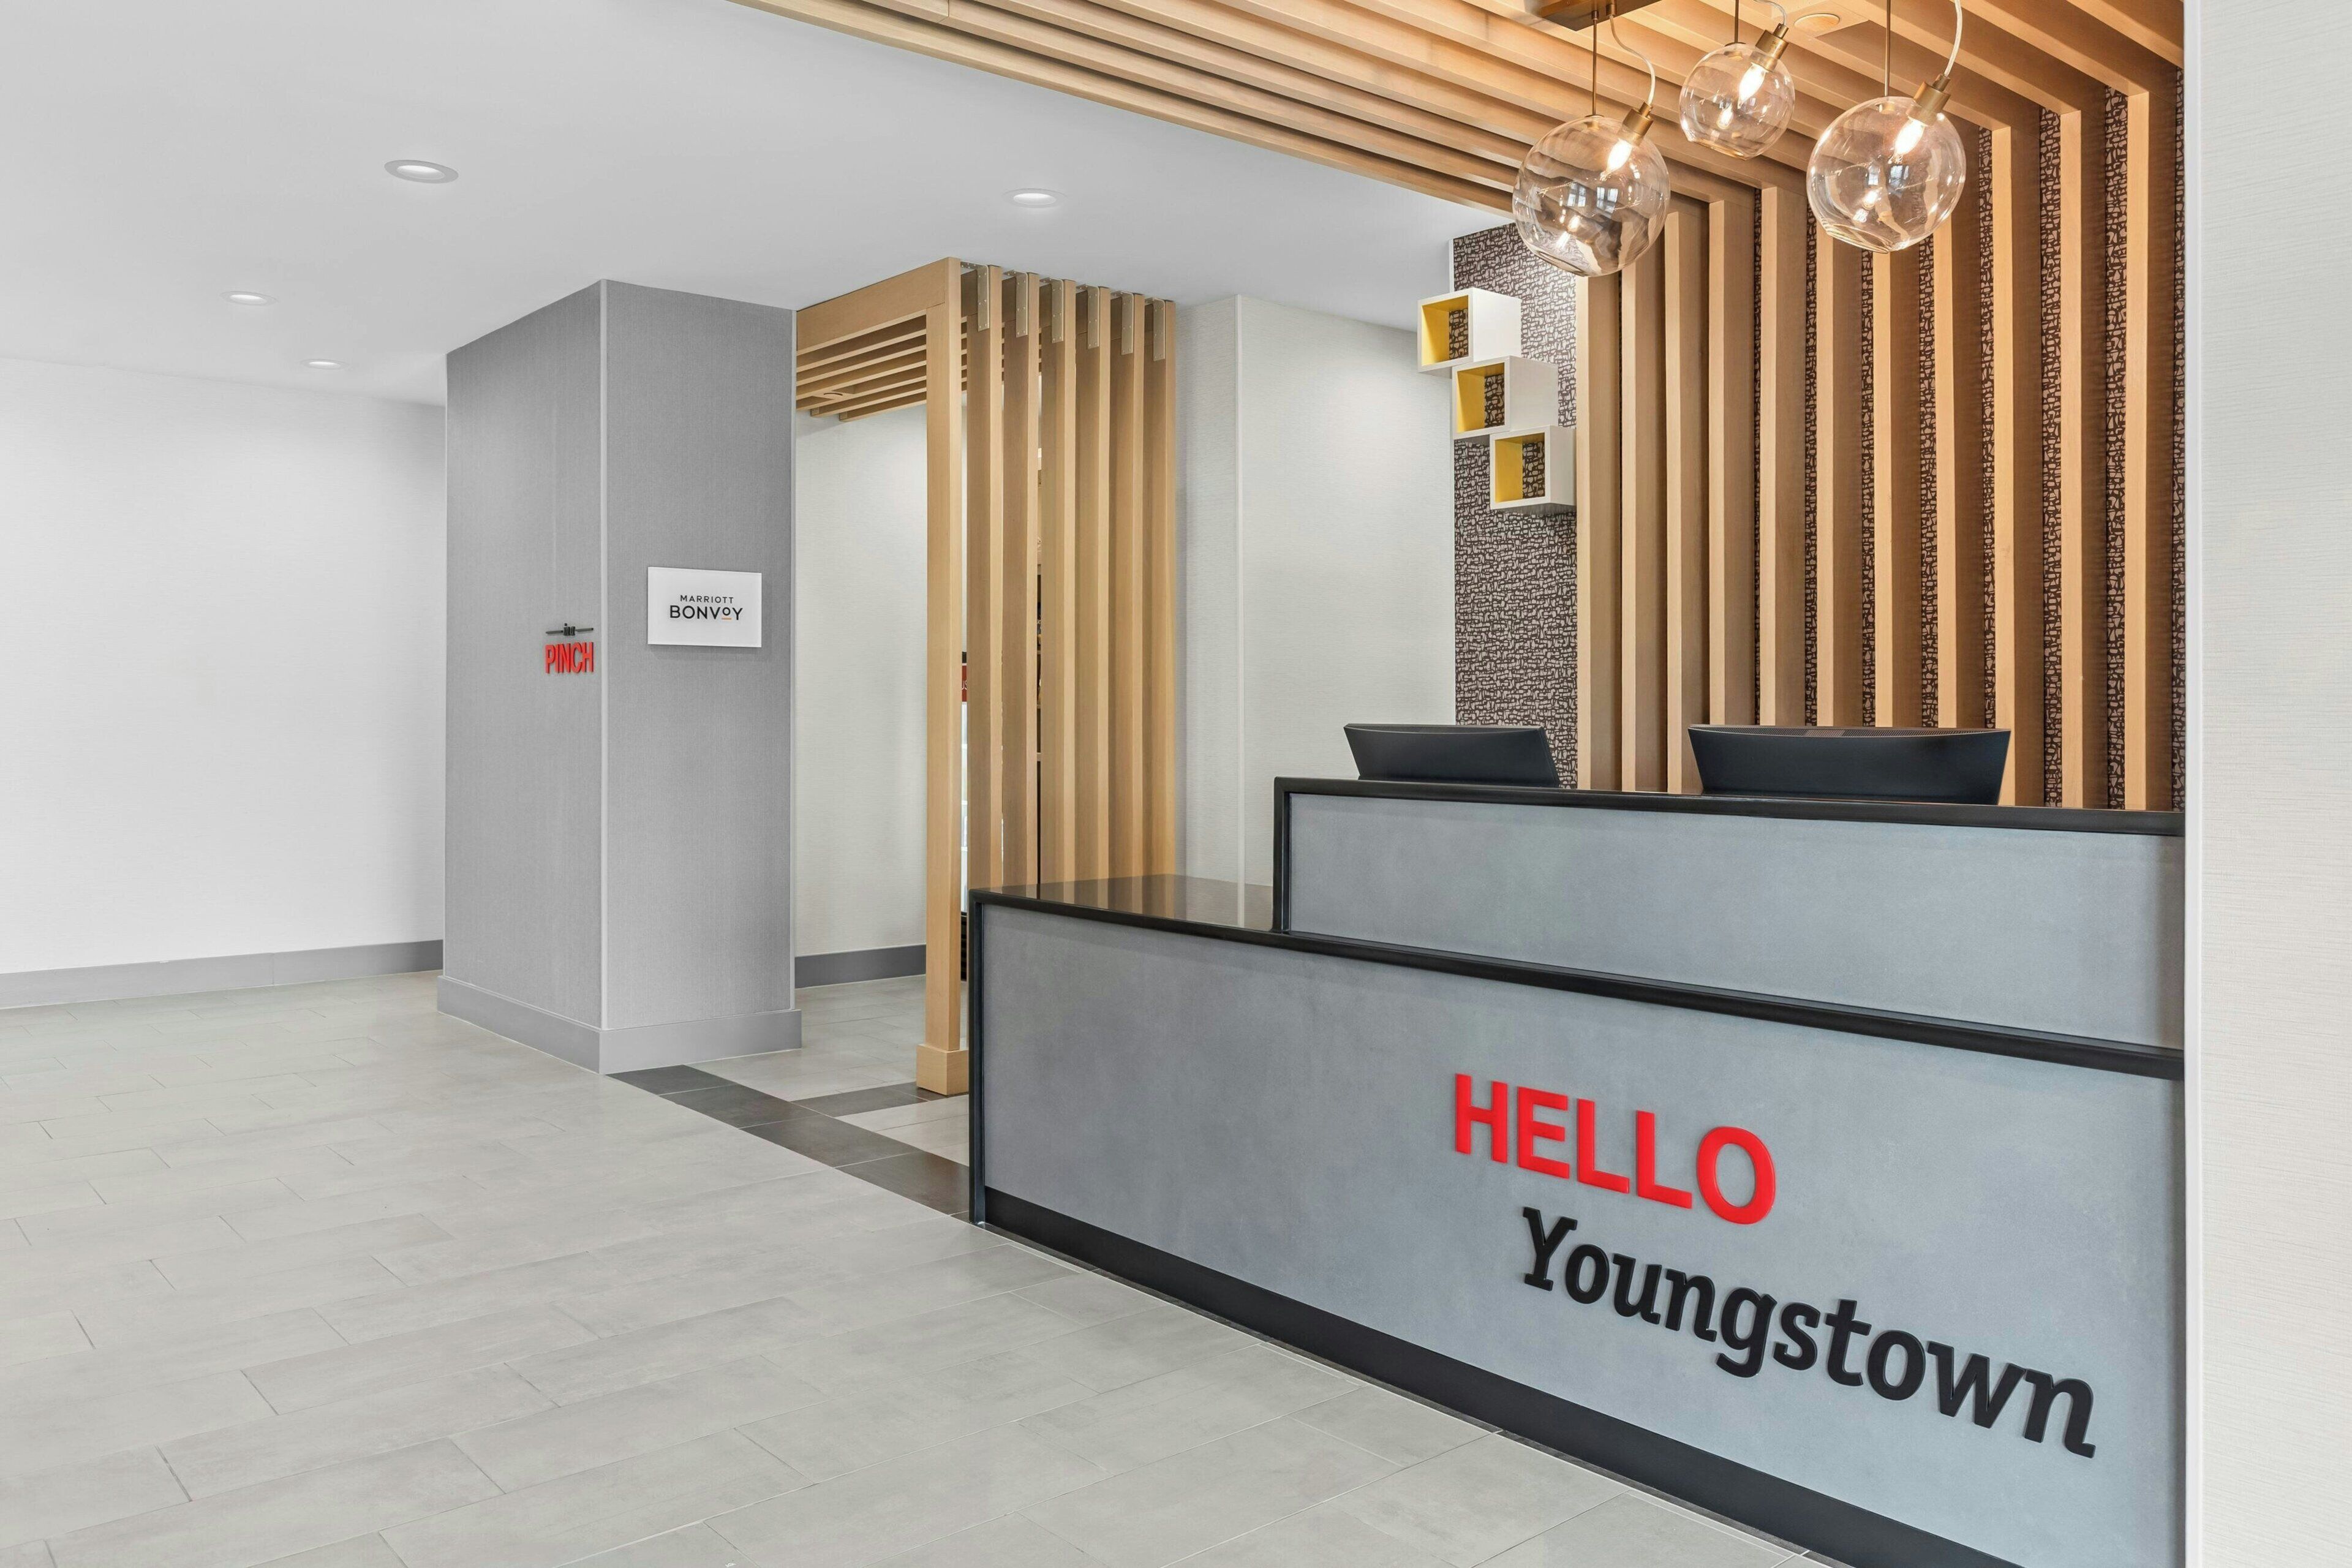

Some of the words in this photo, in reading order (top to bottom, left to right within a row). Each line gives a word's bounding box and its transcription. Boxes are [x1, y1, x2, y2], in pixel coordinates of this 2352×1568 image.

[669, 605, 743, 620] BONVOY
[680, 595, 734, 604] MARRIOTT
[545, 641, 594, 674] PINCH
[1454, 1073, 1776, 1225] HELLO
[1521, 1207, 2096, 1458] Youngstown
